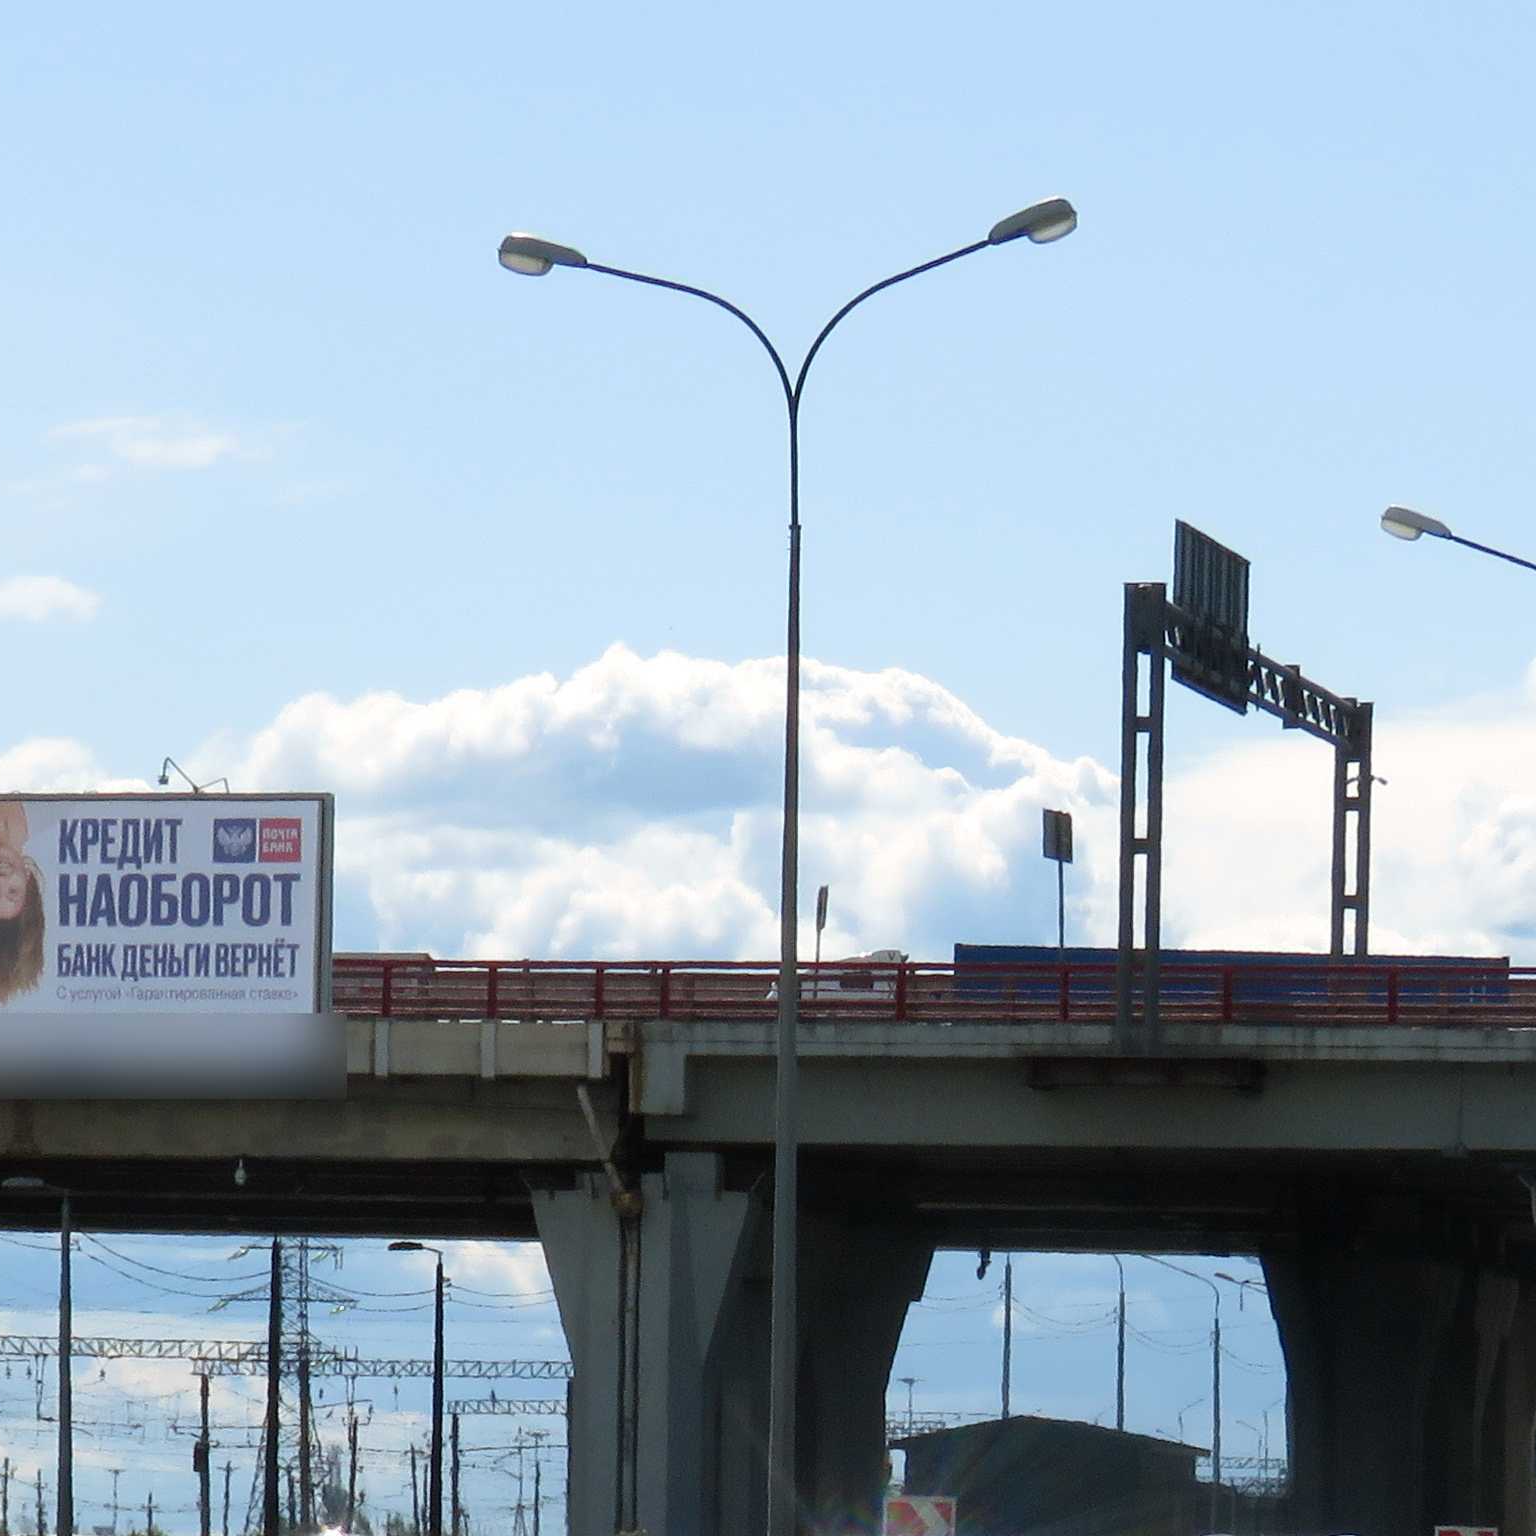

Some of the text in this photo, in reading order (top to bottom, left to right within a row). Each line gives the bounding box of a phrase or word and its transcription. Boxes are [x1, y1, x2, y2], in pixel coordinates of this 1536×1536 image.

[59, 818, 183, 870] КРЕДИТ
[59, 872, 302, 927] НАОБОРОТ
[57, 938, 300, 981] БАНК ДЕНЬГИ ВЕРНЁТ
